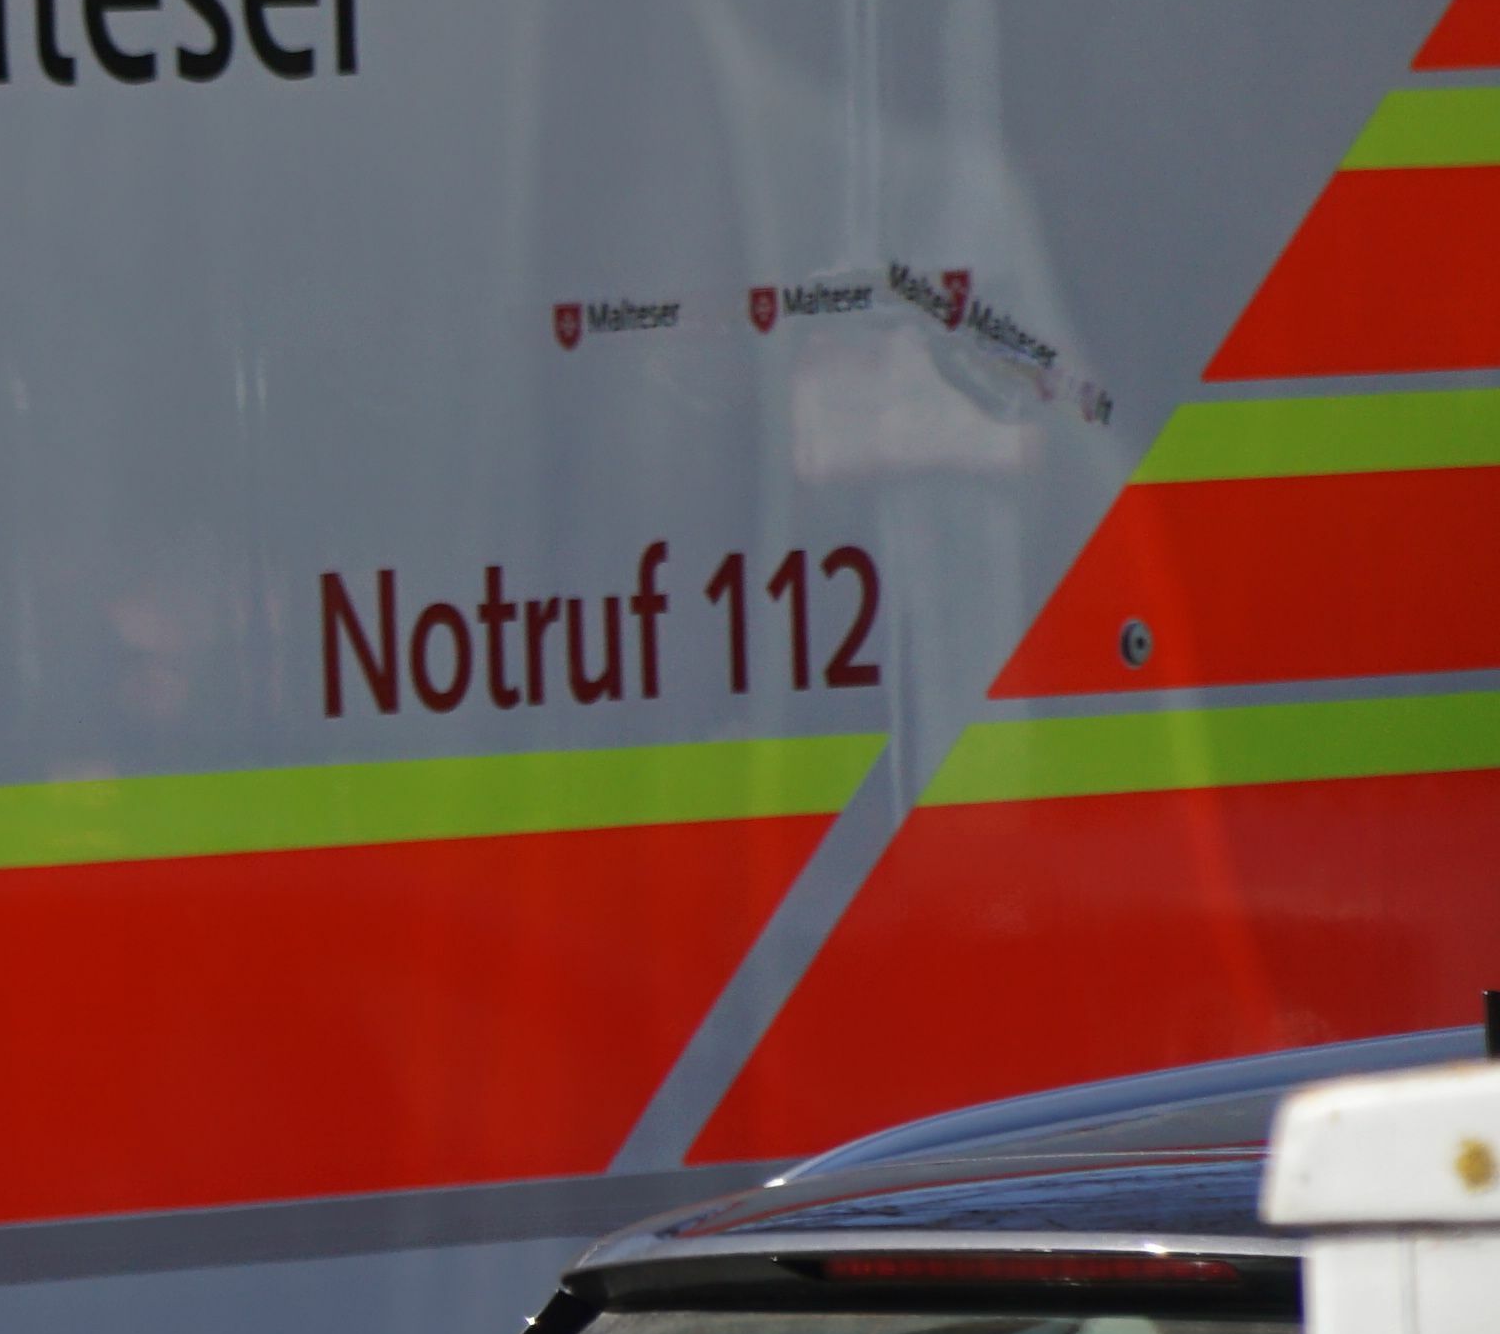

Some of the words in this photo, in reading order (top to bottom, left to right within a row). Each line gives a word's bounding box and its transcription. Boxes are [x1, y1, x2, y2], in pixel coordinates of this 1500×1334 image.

[784, 284, 873, 316] Malteser
[588, 301, 680, 332] Malteser
[319, 540, 668, 719] Notruf
[704, 545, 883, 695] 112
